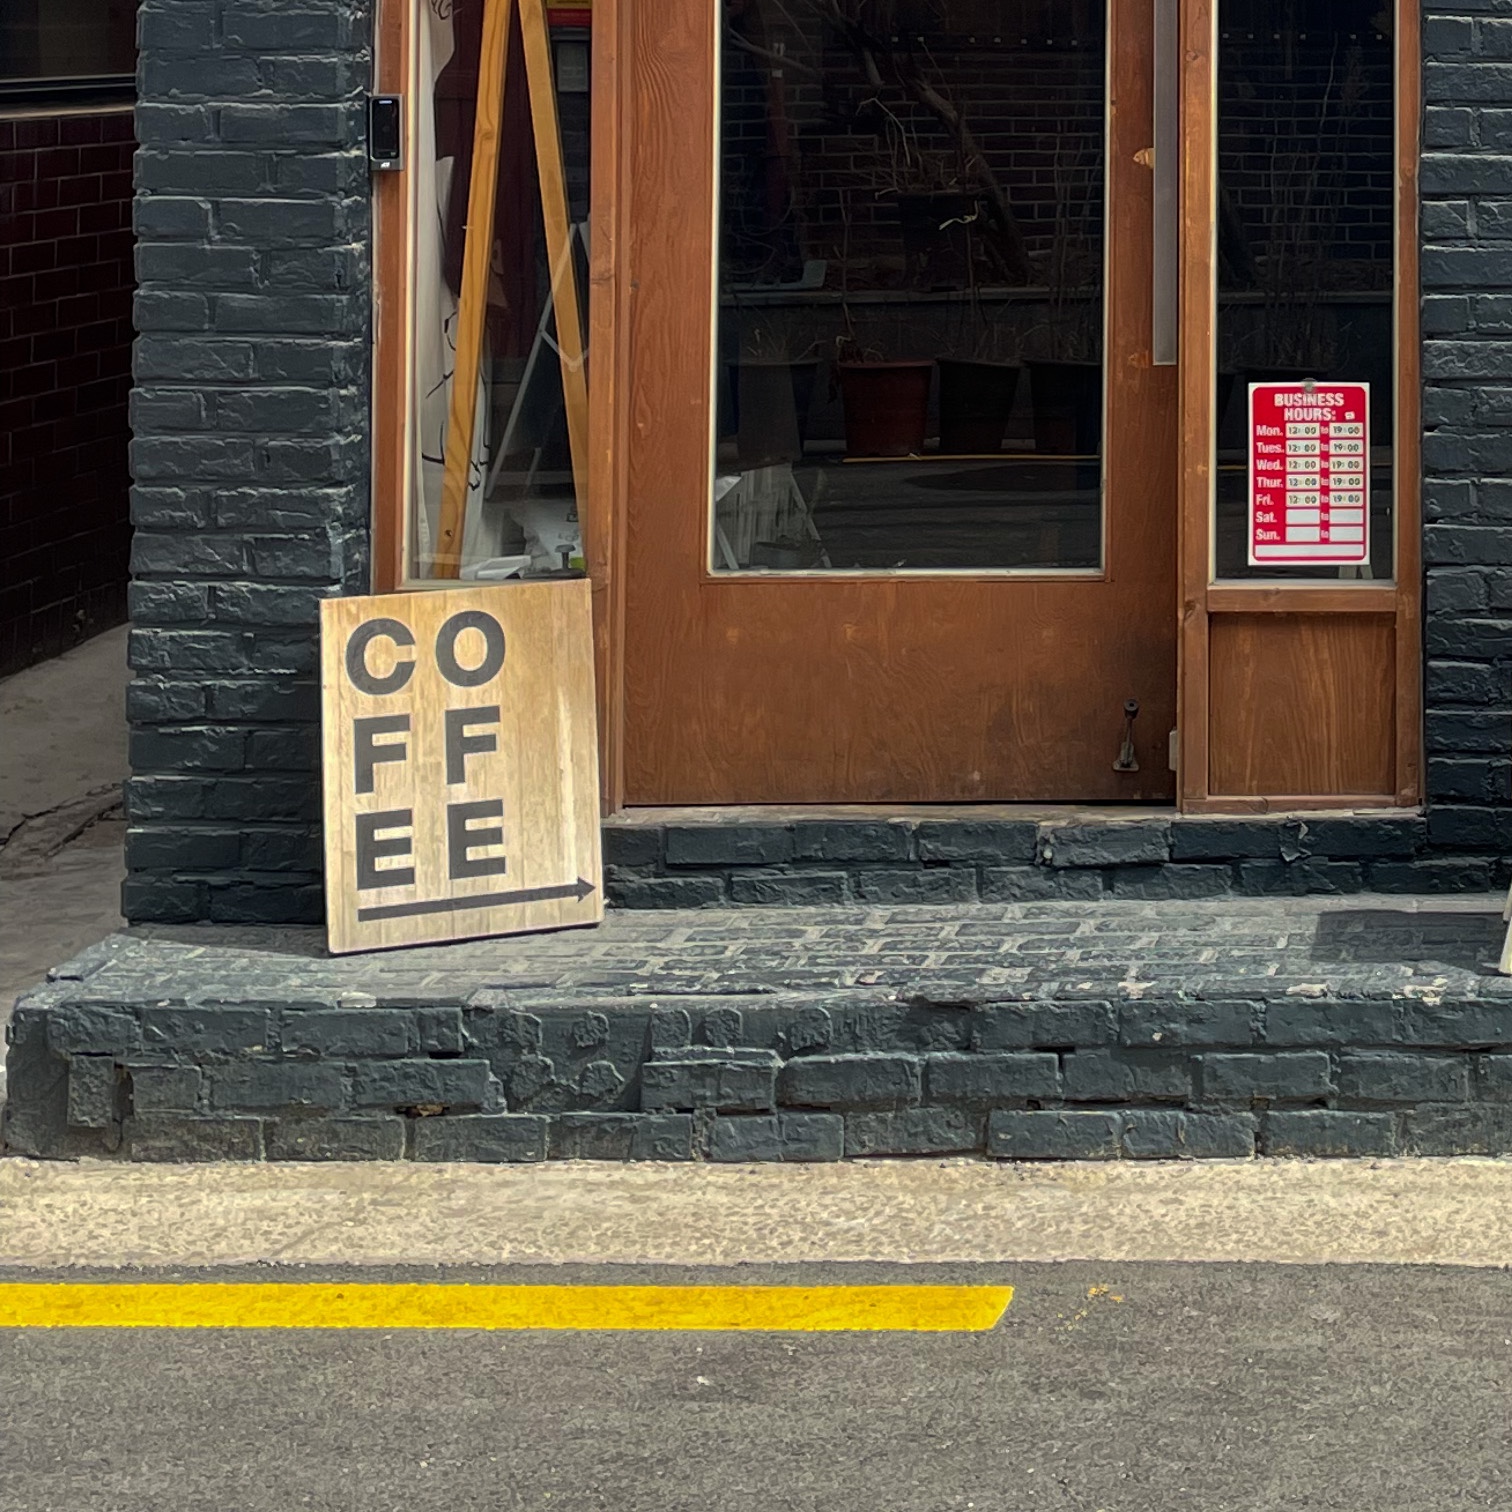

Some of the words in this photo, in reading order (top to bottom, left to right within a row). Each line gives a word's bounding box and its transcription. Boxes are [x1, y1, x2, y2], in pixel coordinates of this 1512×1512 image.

[1274, 393, 1344, 406] BUSINESS
[1284, 408, 1336, 421] HOURS:
[1256, 424, 1283, 436] Mon.
[1256, 443, 1284, 453] Tues.
[1256, 459, 1282, 470] Wed.
[1256, 477, 1283, 488] Thur.
[1256, 494, 1274, 505] Fri.
[1256, 511, 1277, 523] Sat.
[1256, 530, 1280, 540] Sun.
